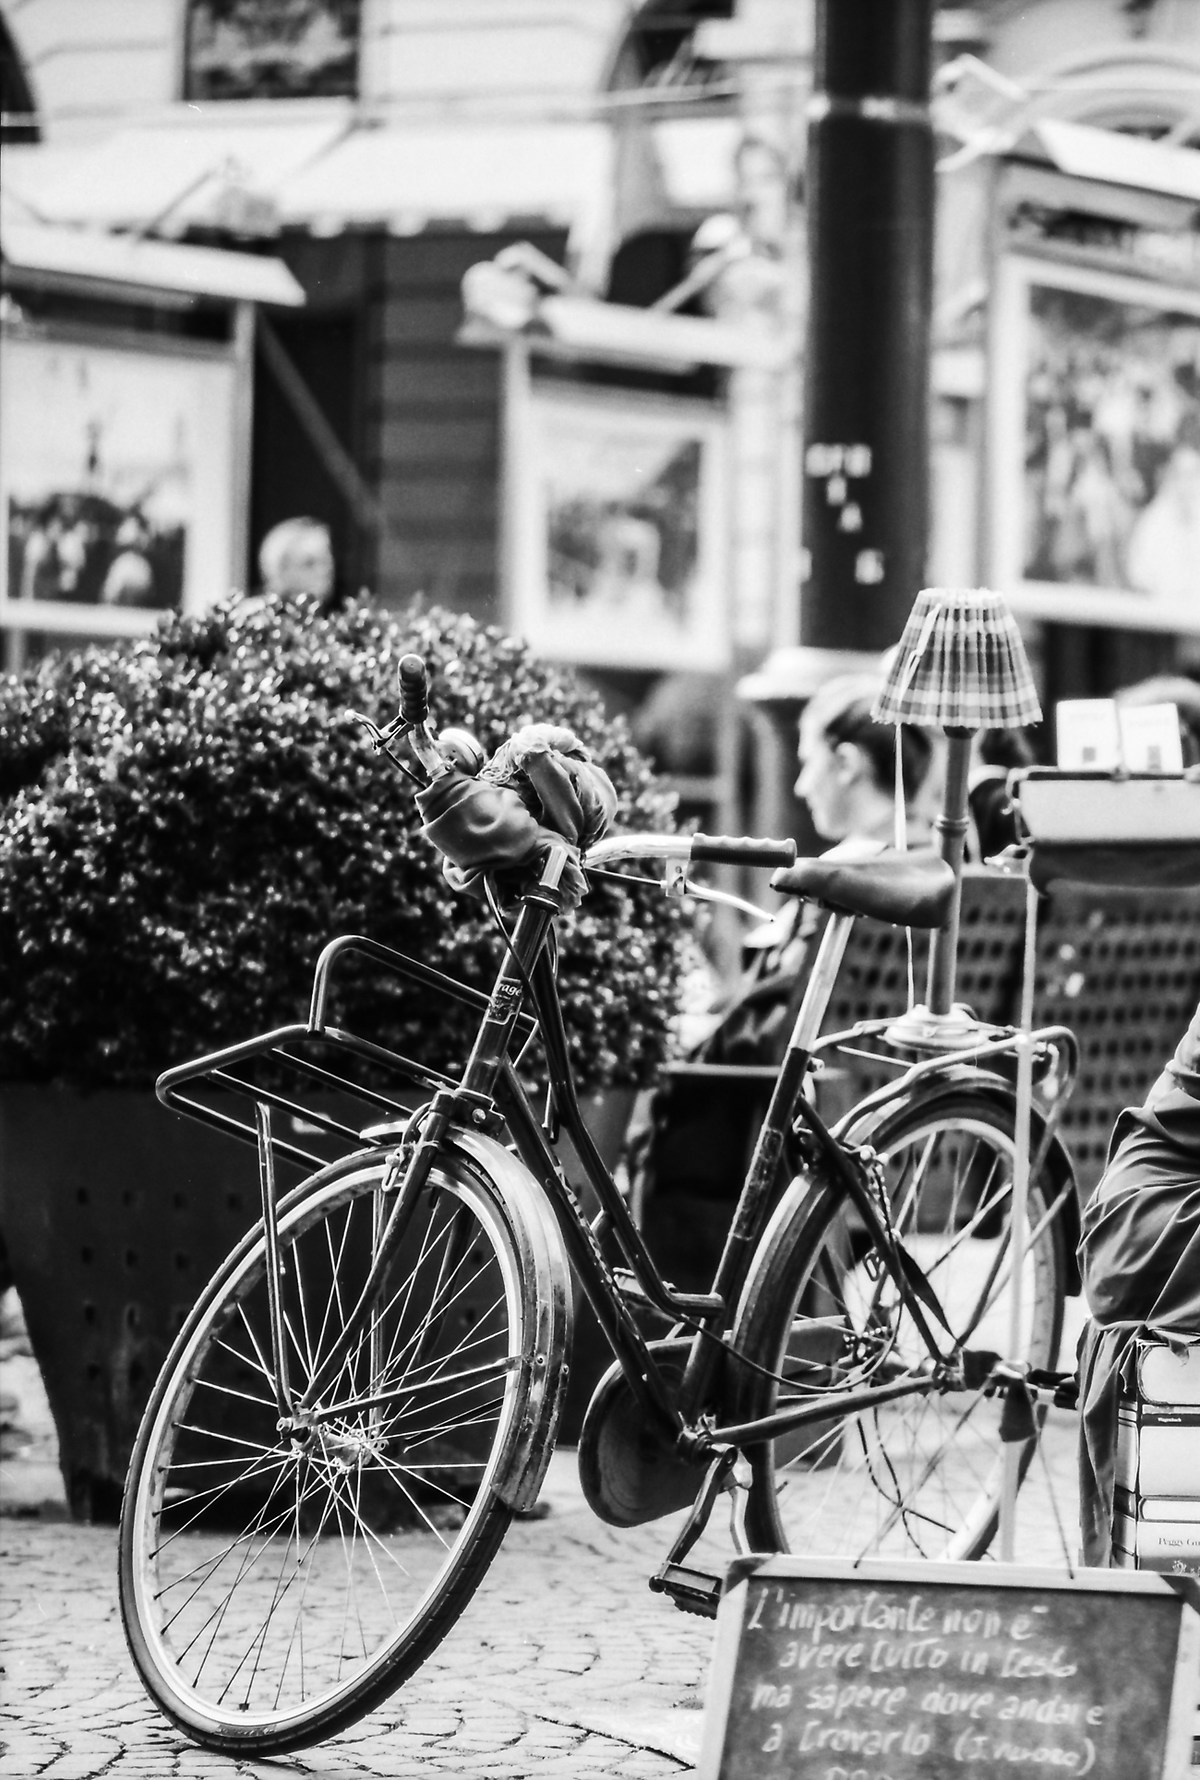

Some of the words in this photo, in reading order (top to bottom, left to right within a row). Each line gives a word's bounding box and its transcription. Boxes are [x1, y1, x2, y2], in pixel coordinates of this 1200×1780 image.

[1157, 1536, 1184, 1547] Peggy
[942, 1605, 1002, 1639] non
[778, 1641, 865, 1670] avere
[961, 1651, 990, 1676] in
[750, 1682, 792, 1710] ma
[805, 1683, 907, 1720] sapere
[920, 1681, 994, 1719] dove
